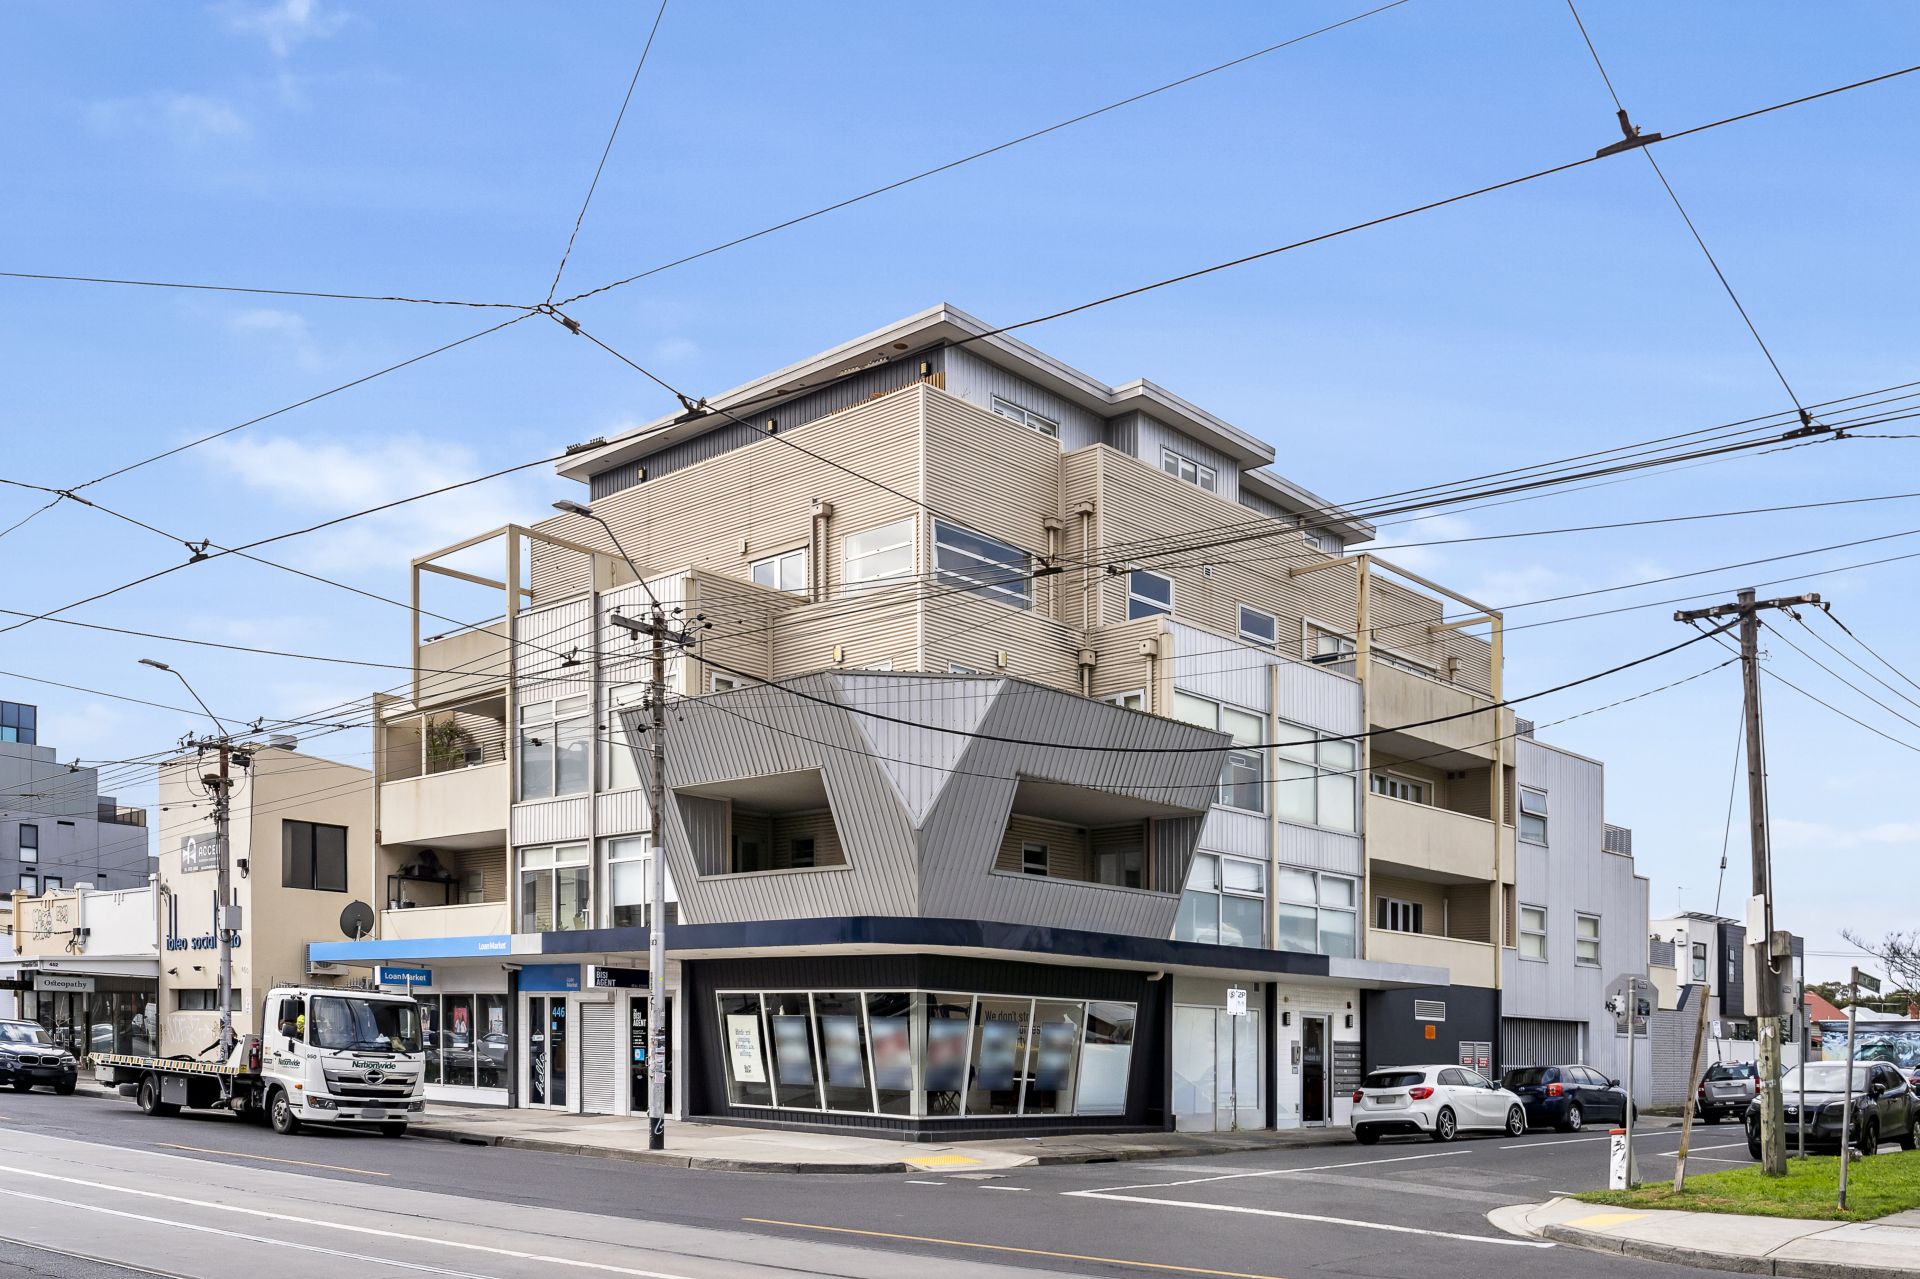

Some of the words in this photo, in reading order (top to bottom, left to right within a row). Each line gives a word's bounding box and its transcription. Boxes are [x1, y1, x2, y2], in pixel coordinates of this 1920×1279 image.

[490, 942, 506, 950] Market
[384, 972, 402, 980] Loan
[402, 972, 426, 981] Market
[596, 971, 609, 979] BISI
[44, 980, 87, 989] Osteopathy
[596, 979, 617, 987] AGENT
[552, 1007, 565, 1018] 446
[984, 1010, 997, 1021] We
[998, 1010, 1017, 1021] don't
[633, 1019, 646, 1027] AGENT
[278, 1058, 301, 1067] Nationwide
[352, 1060, 396, 1070] Nationwide
[535, 1052, 545, 1097] hello
